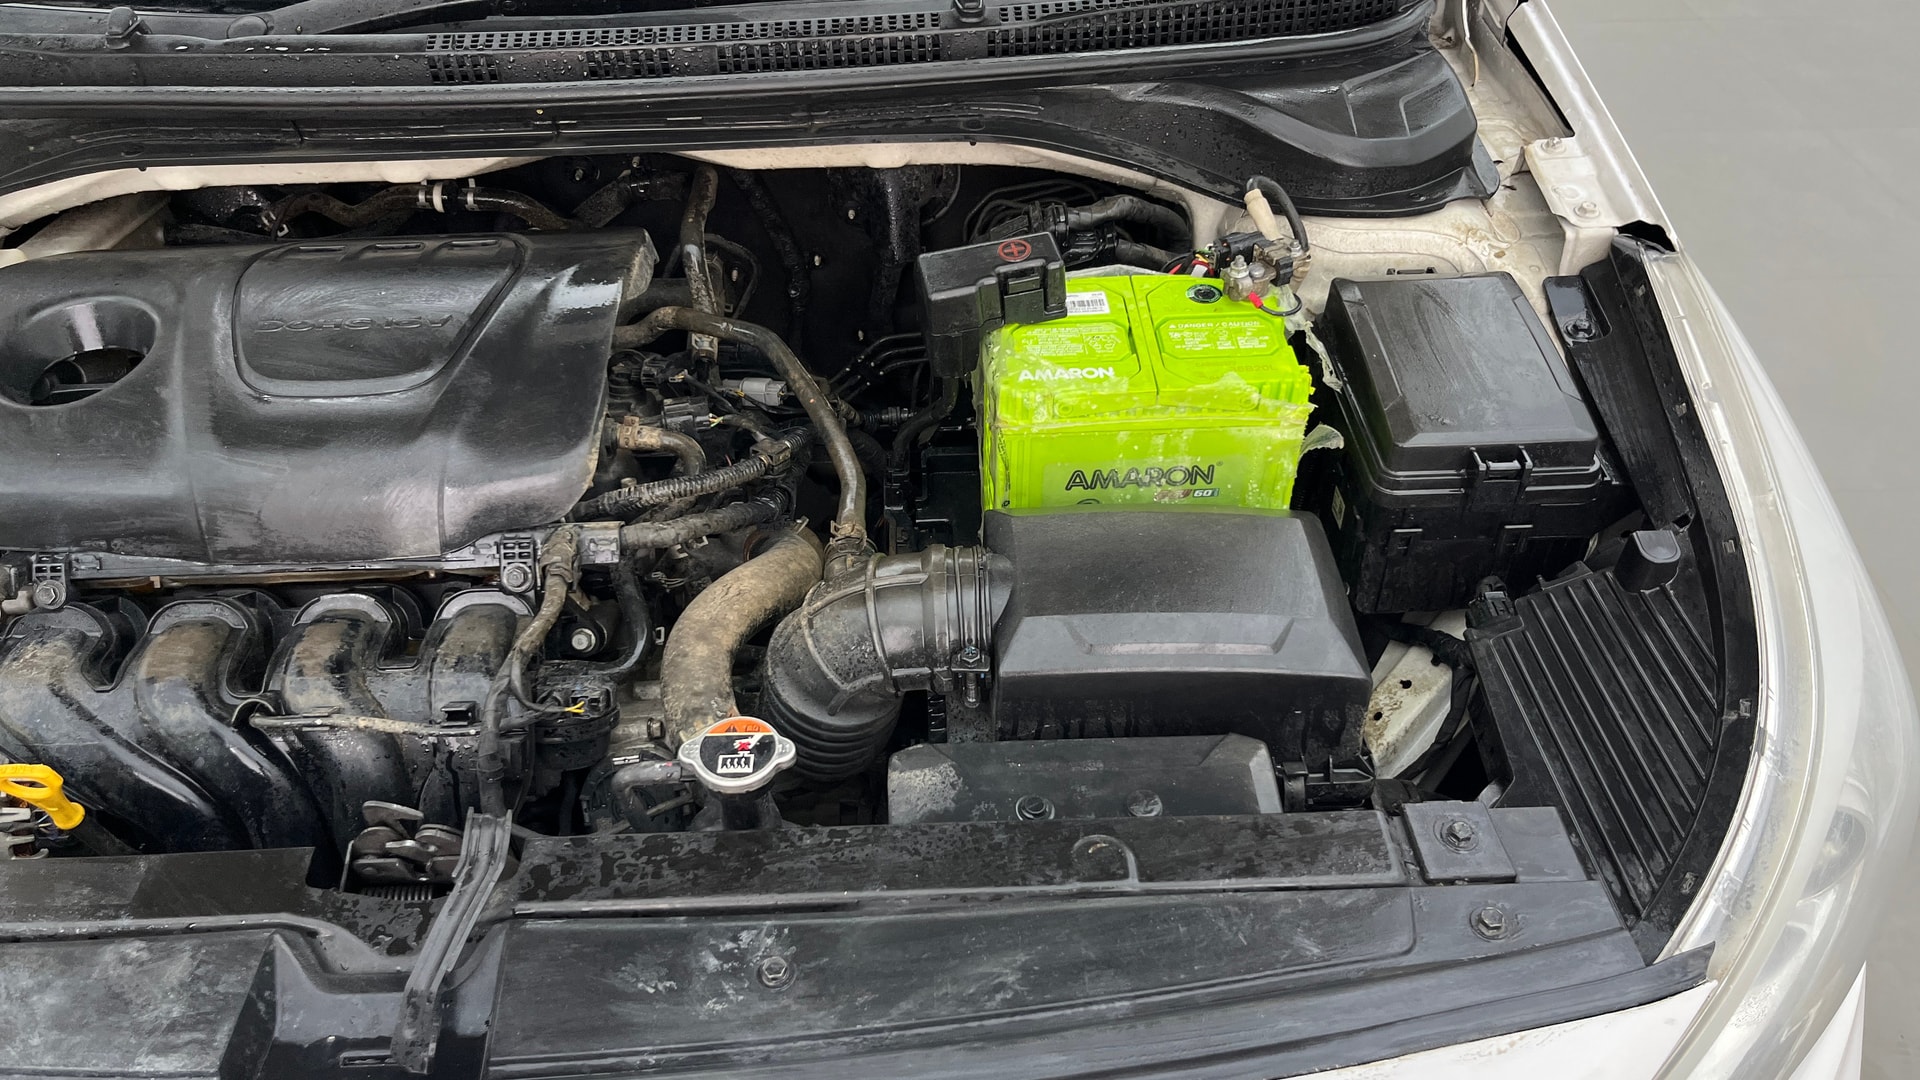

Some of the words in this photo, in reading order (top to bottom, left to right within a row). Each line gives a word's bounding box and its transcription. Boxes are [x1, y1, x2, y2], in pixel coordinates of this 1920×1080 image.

[1221, 320, 1260, 328] CAUTION
[1018, 366, 1115, 382] AMARON
[1065, 464, 1215, 491] AMARON
